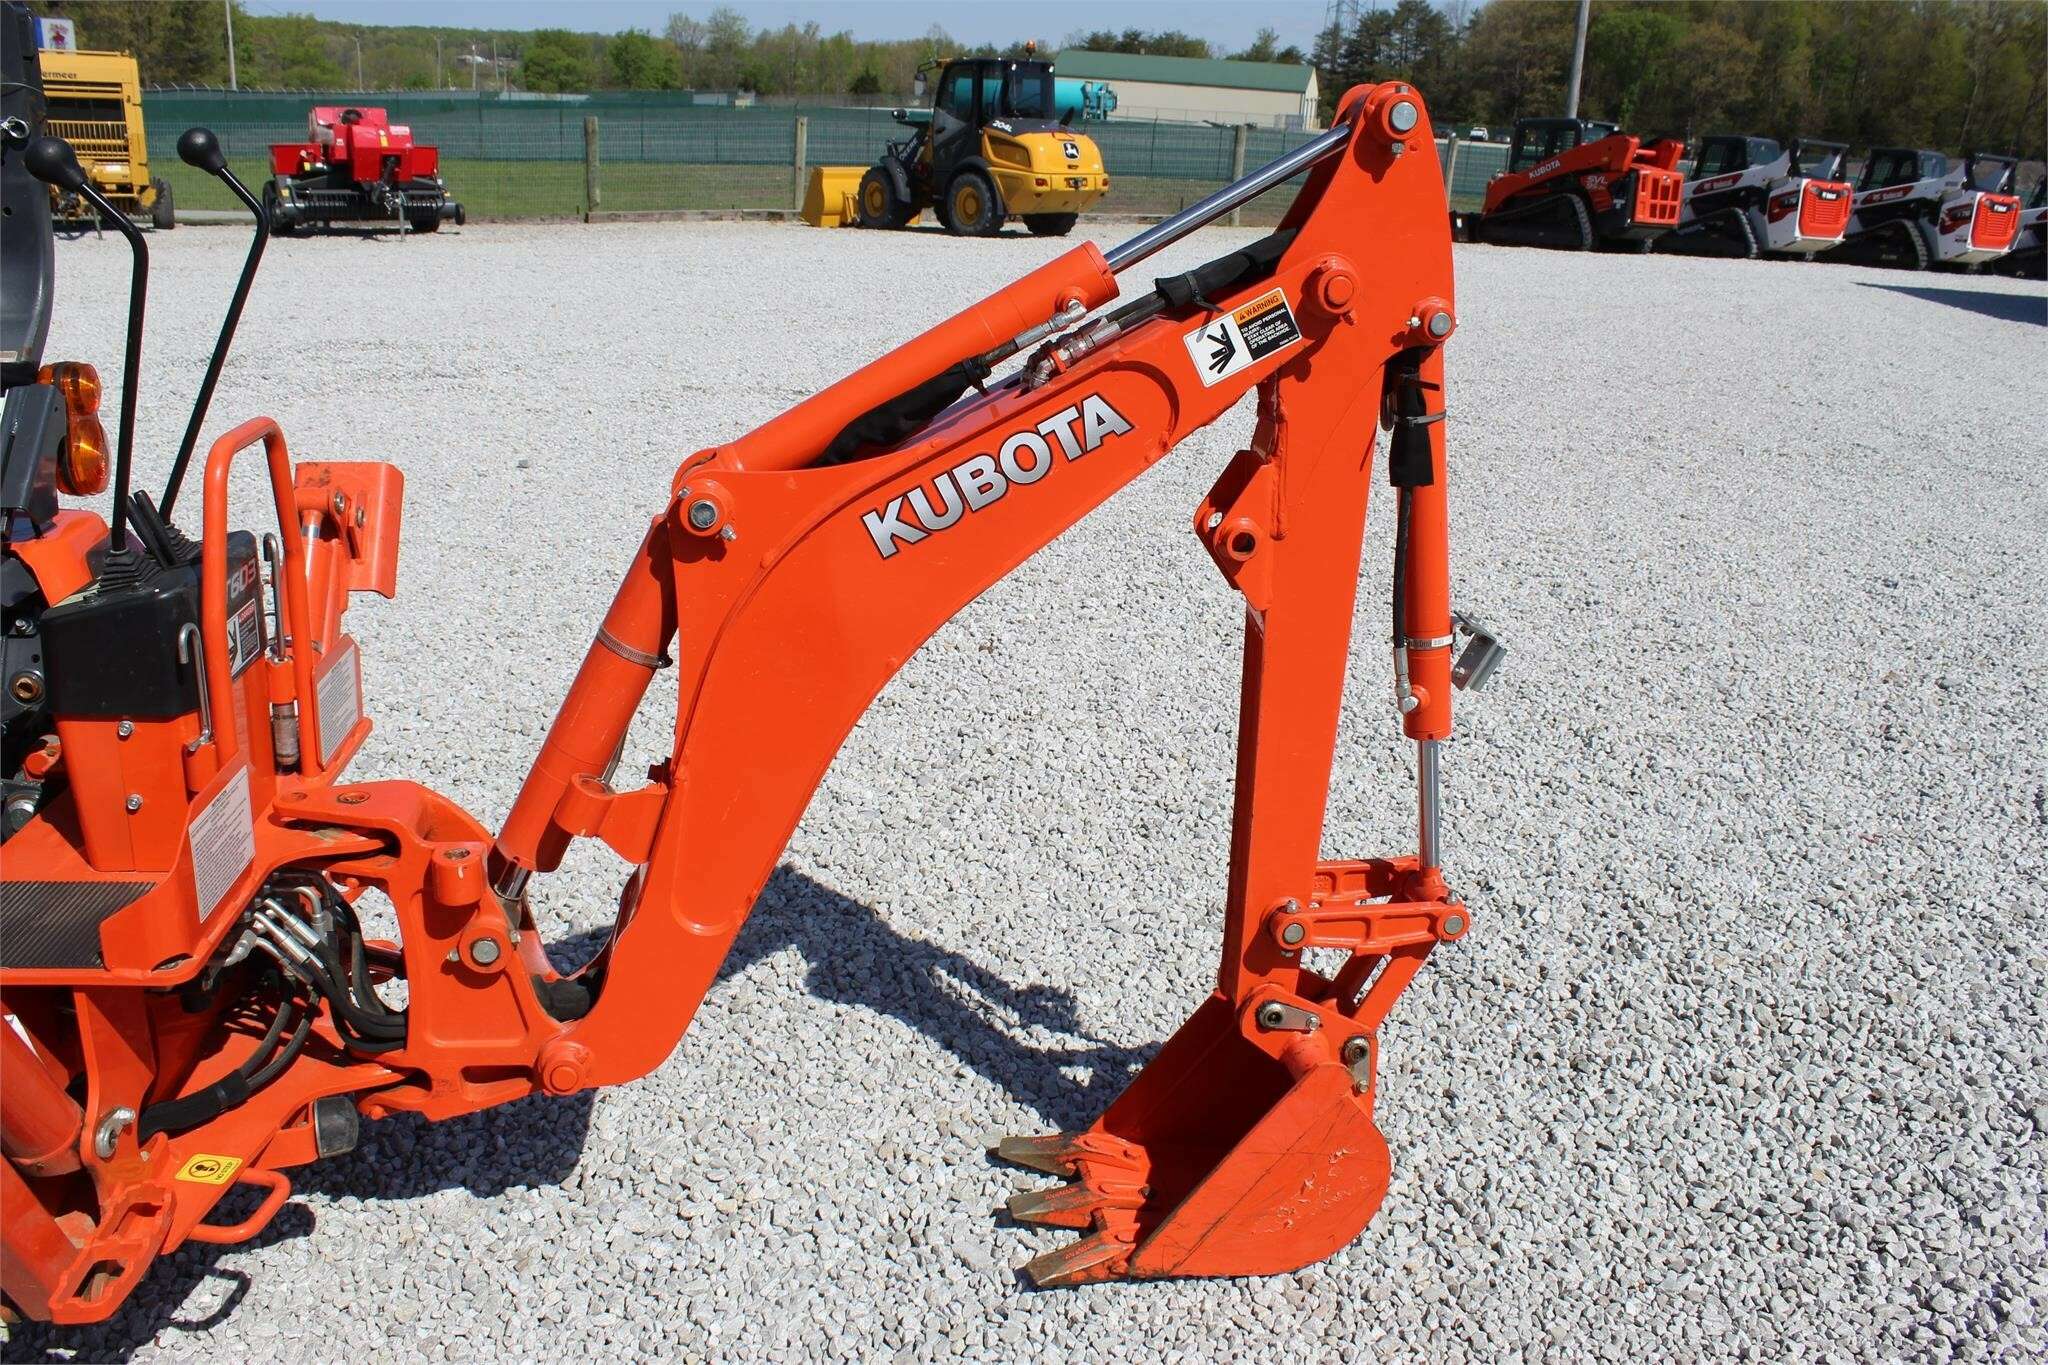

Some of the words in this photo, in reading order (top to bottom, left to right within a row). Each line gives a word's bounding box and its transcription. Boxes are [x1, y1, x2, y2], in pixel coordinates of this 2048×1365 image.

[42, 71, 77, 79] ermeer
[1529, 159, 1561, 179] KUBOTA
[1246, 295, 1279, 316] WARNING
[1248, 320, 1263, 329] AVOID
[1262, 307, 1287, 322] PERSONAL
[1247, 332, 1259, 340] STAY
[1259, 324, 1275, 334] CLEAR
[1249, 329, 1275, 345] OPERATING
[1275, 322, 1288, 332] AREA
[862, 395, 1134, 559] KUBOTA
